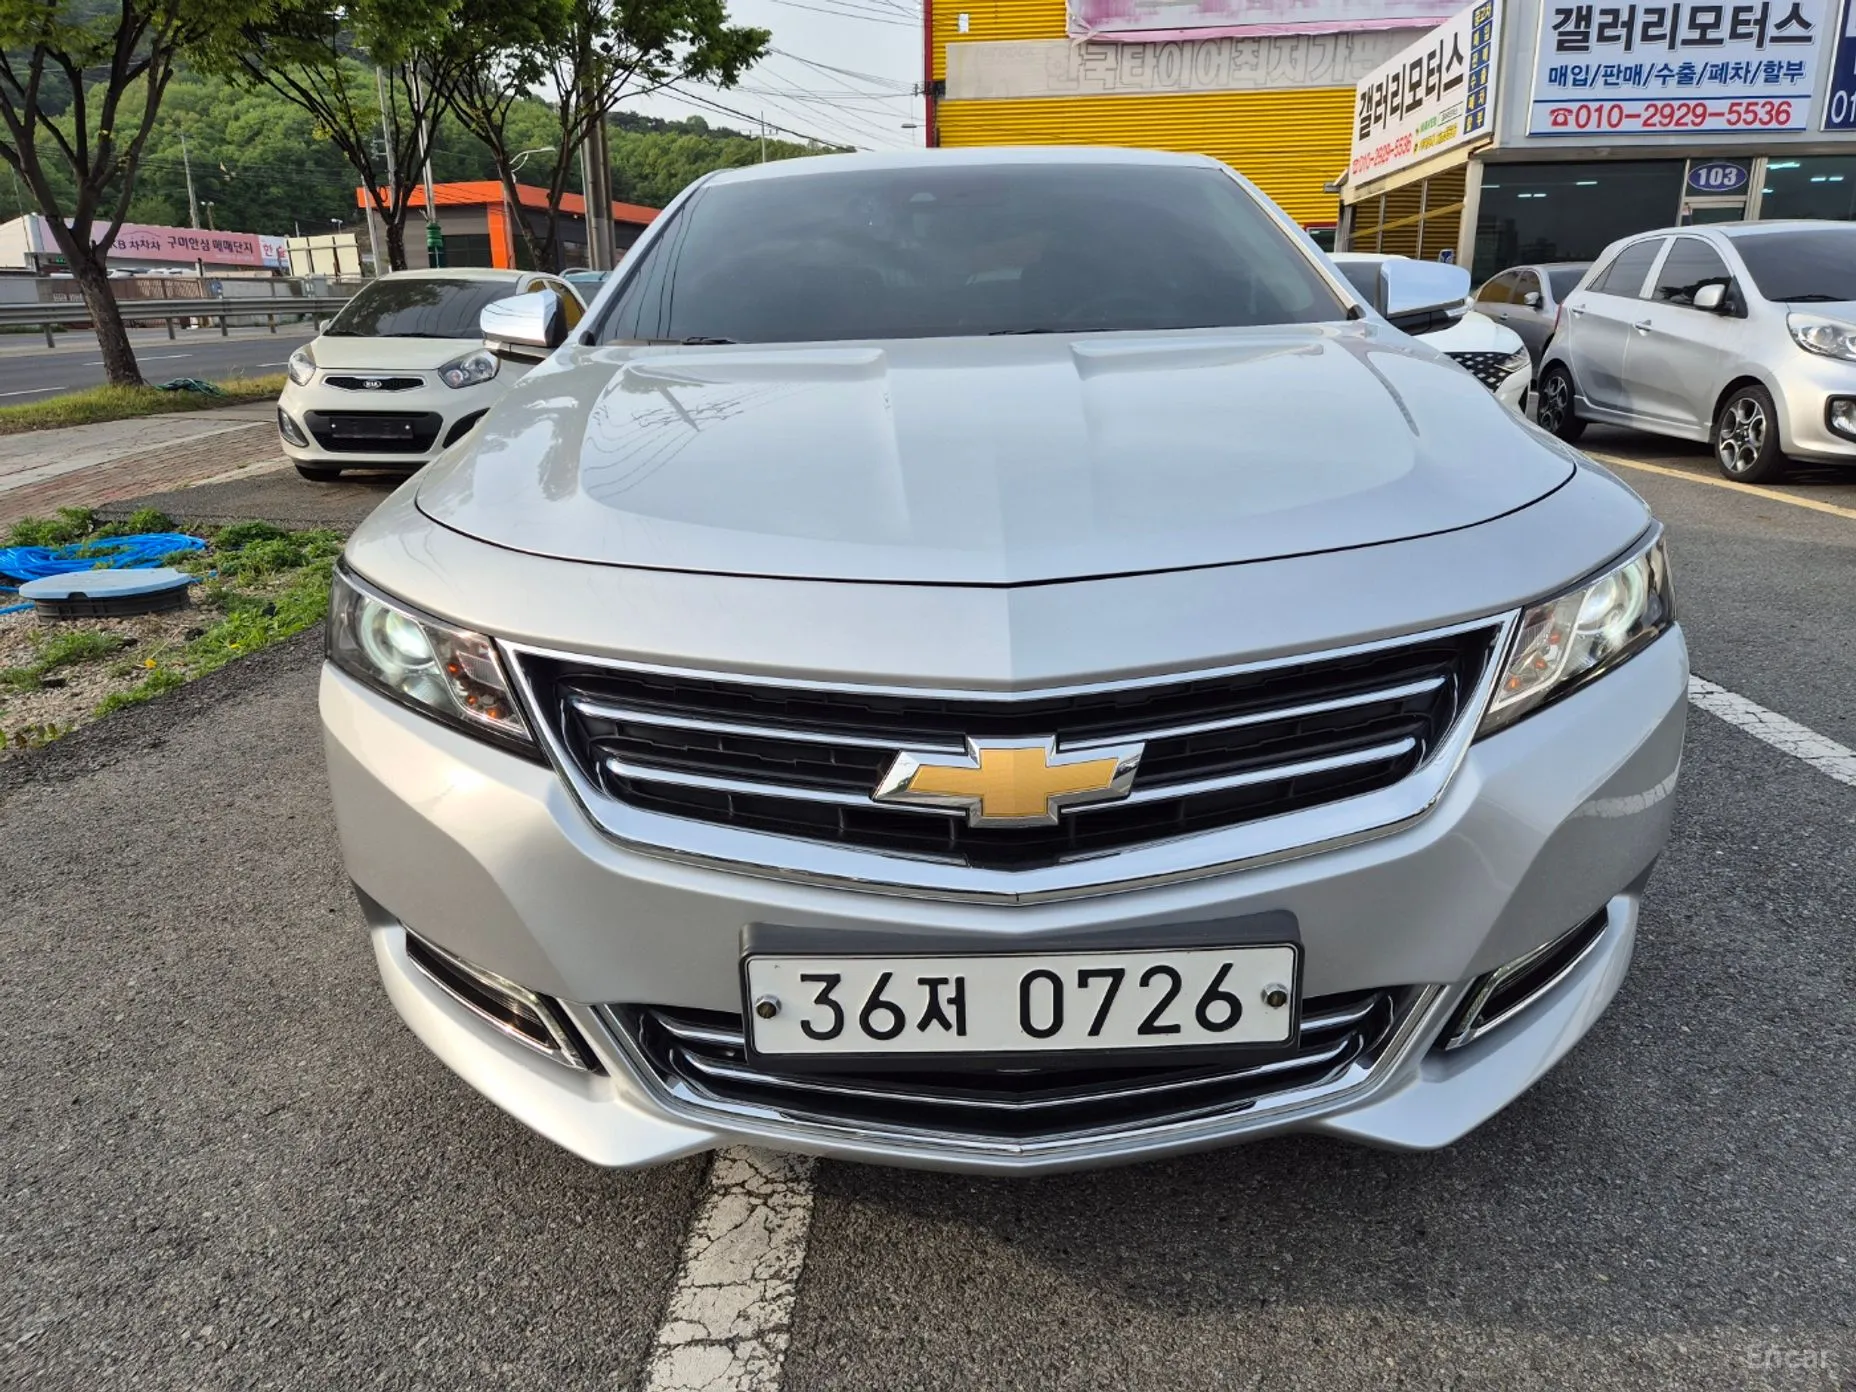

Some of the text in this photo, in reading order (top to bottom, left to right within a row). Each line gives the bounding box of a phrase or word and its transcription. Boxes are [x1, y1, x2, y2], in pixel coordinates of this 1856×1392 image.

[1551, 1, 1814, 51] 갤러리모터스
[1359, 32, 1464, 141] 갤러리모터스
[1574, 101, 1792, 129] 010-2929-5536
[1698, 168, 1738, 186] 103
[167, 236, 210, 252] 구미안심
[800, 962, 1244, 1041] 36저 0726
